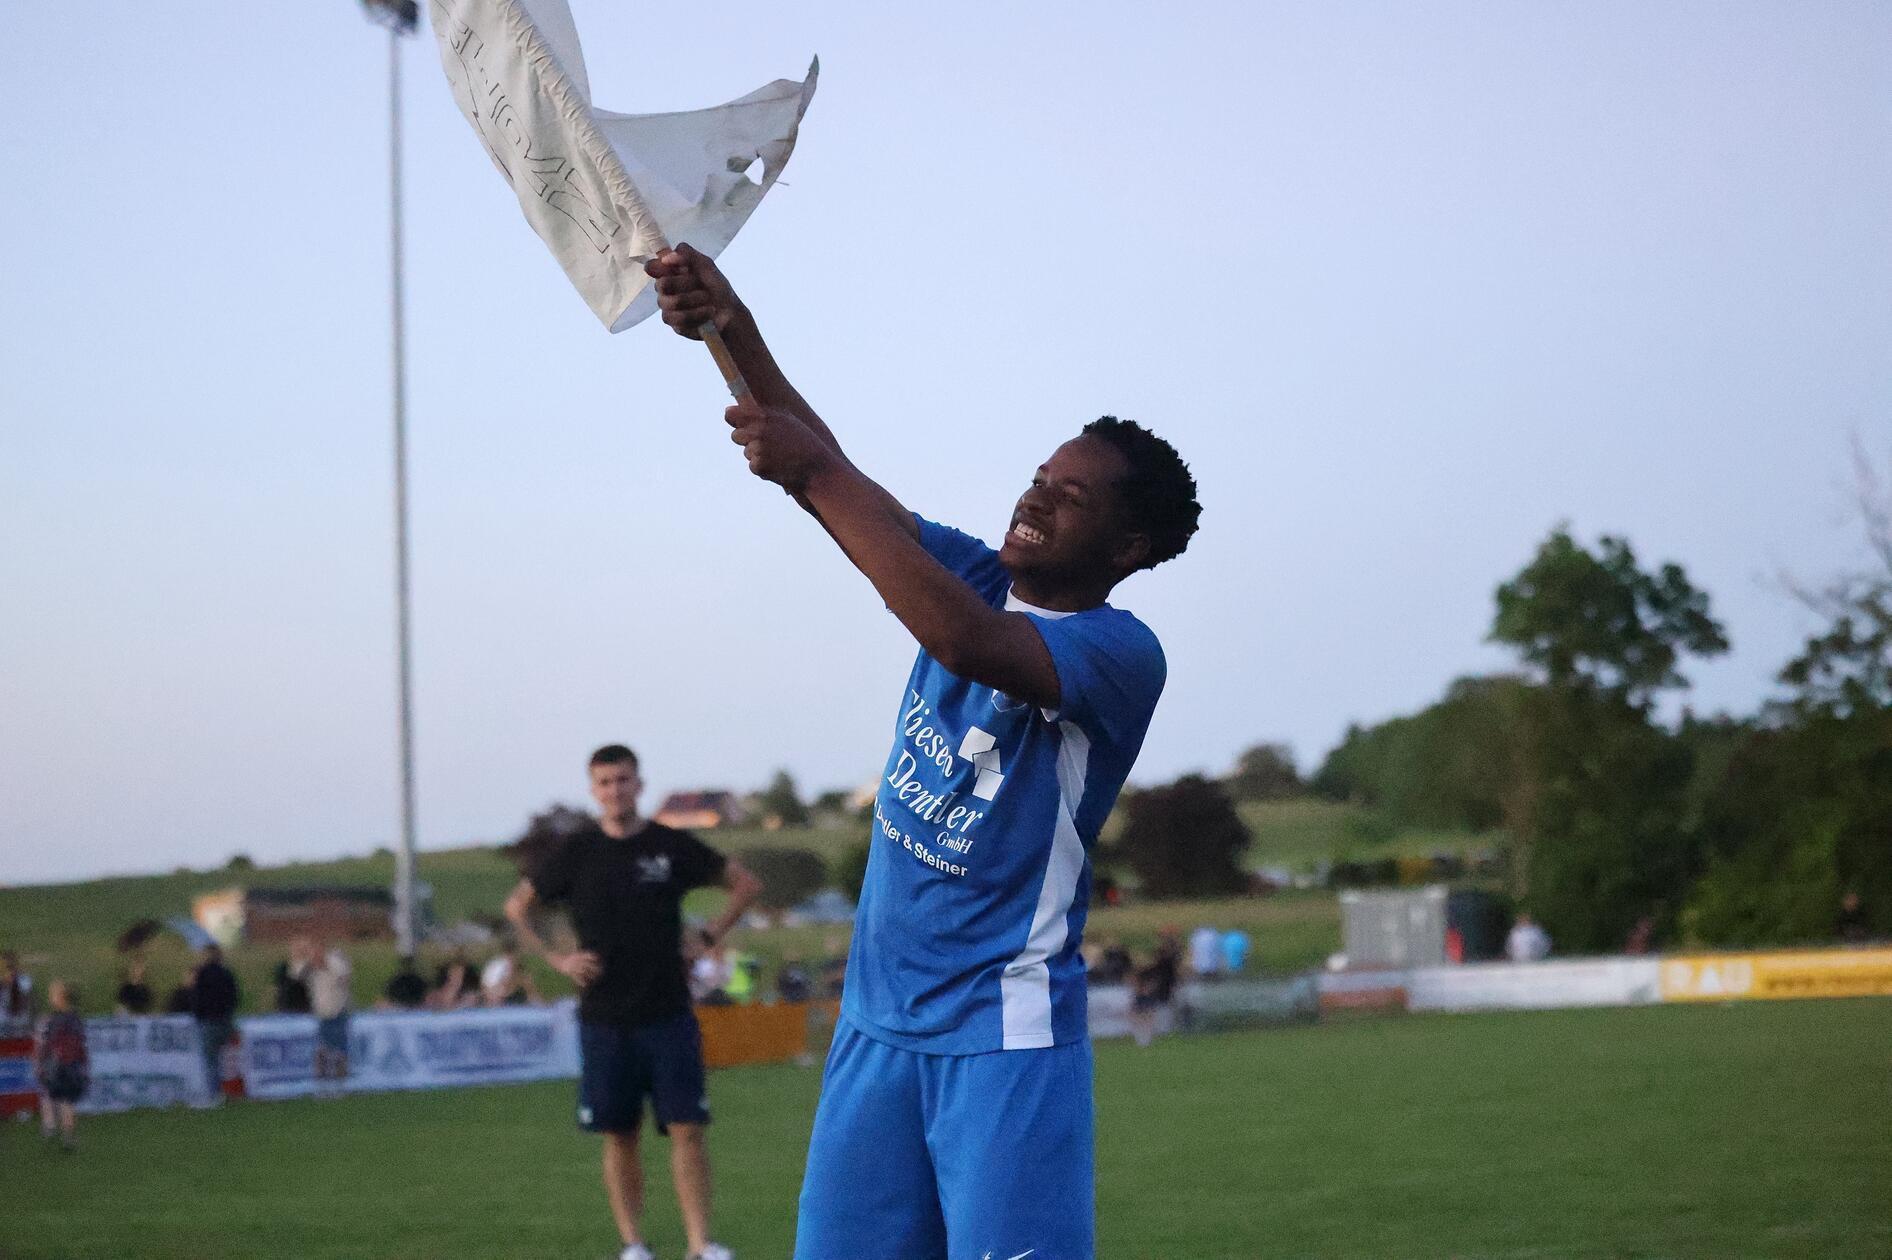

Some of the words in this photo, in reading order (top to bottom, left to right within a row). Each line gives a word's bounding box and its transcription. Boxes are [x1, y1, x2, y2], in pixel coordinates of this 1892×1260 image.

[904, 689, 953, 777] liesen
[888, 749, 983, 833] Dentler
[903, 834, 913, 851] &
[914, 842, 968, 877] Steiner
[936, 831, 973, 854] GmbH
